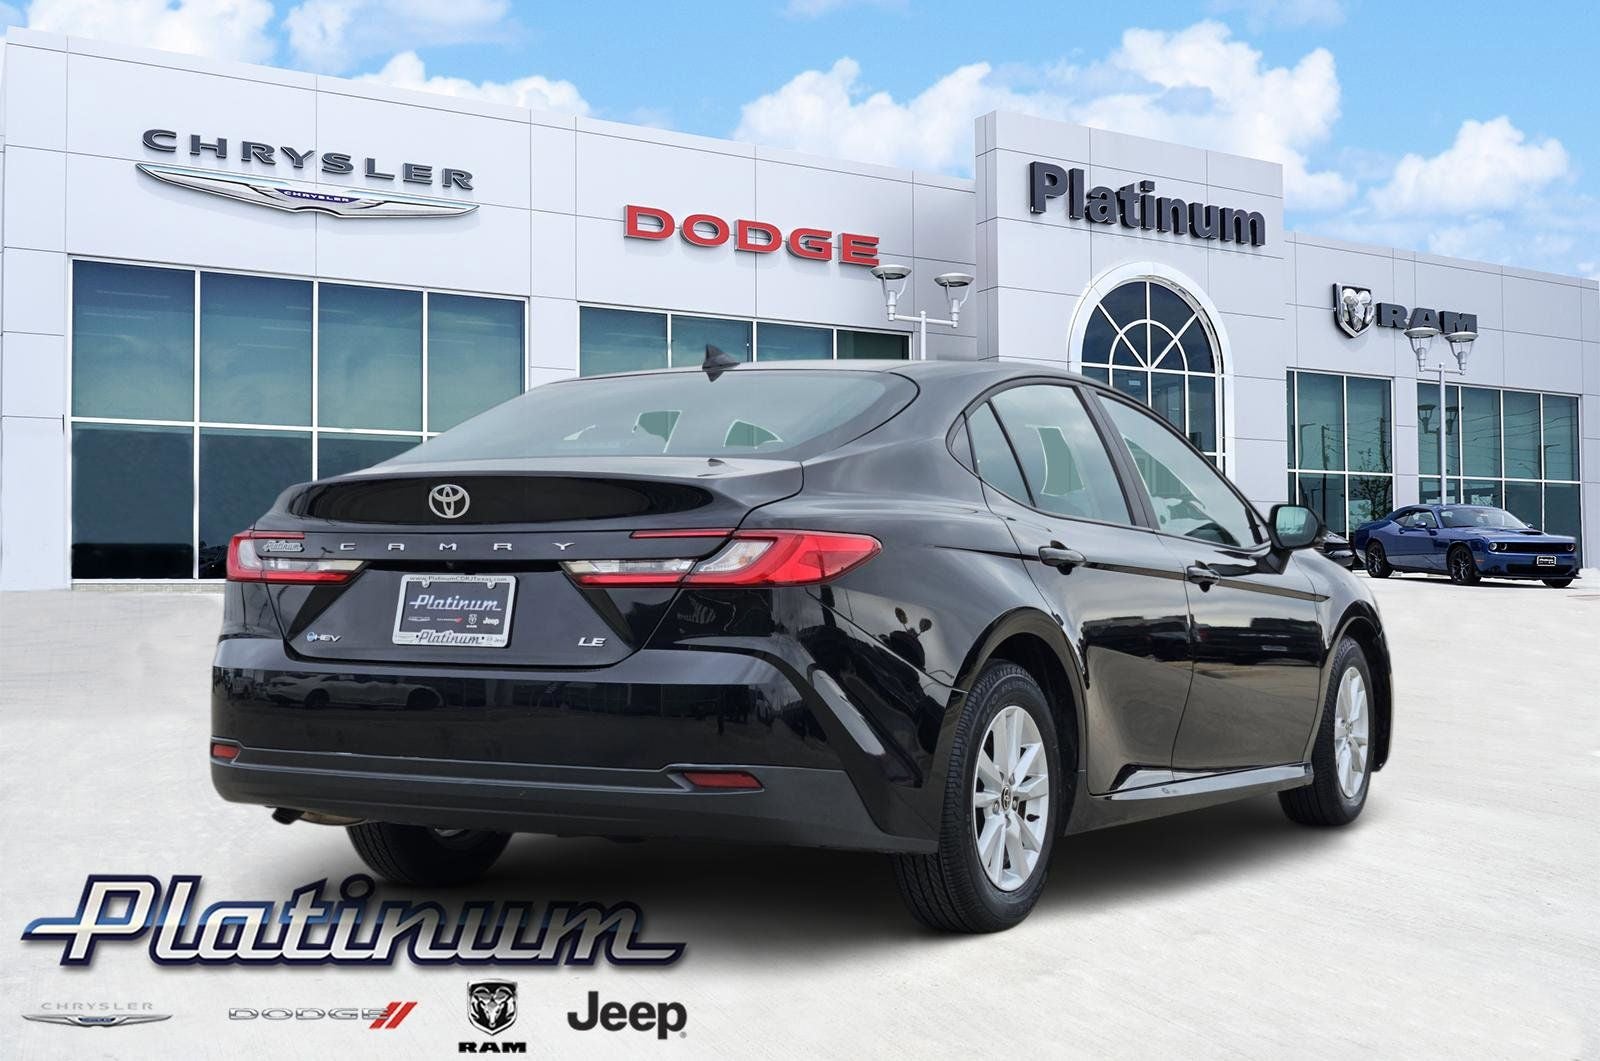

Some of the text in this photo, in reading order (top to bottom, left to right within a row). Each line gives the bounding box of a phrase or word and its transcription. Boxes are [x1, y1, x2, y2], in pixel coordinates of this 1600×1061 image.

[142, 128, 474, 190] CHRYSLER
[283, 190, 349, 202] CHRYSLER
[1028, 160, 1266, 247] Platinum
[623, 204, 880, 267] DODGE
[1376, 302, 1478, 334] RAM
[340, 542, 576, 551] CAMRY
[409, 594, 502, 611] Platinum
[482, 617, 500, 625] Jeep
[418, 630, 481, 645] Platinum
[577, 636, 606, 647] LE
